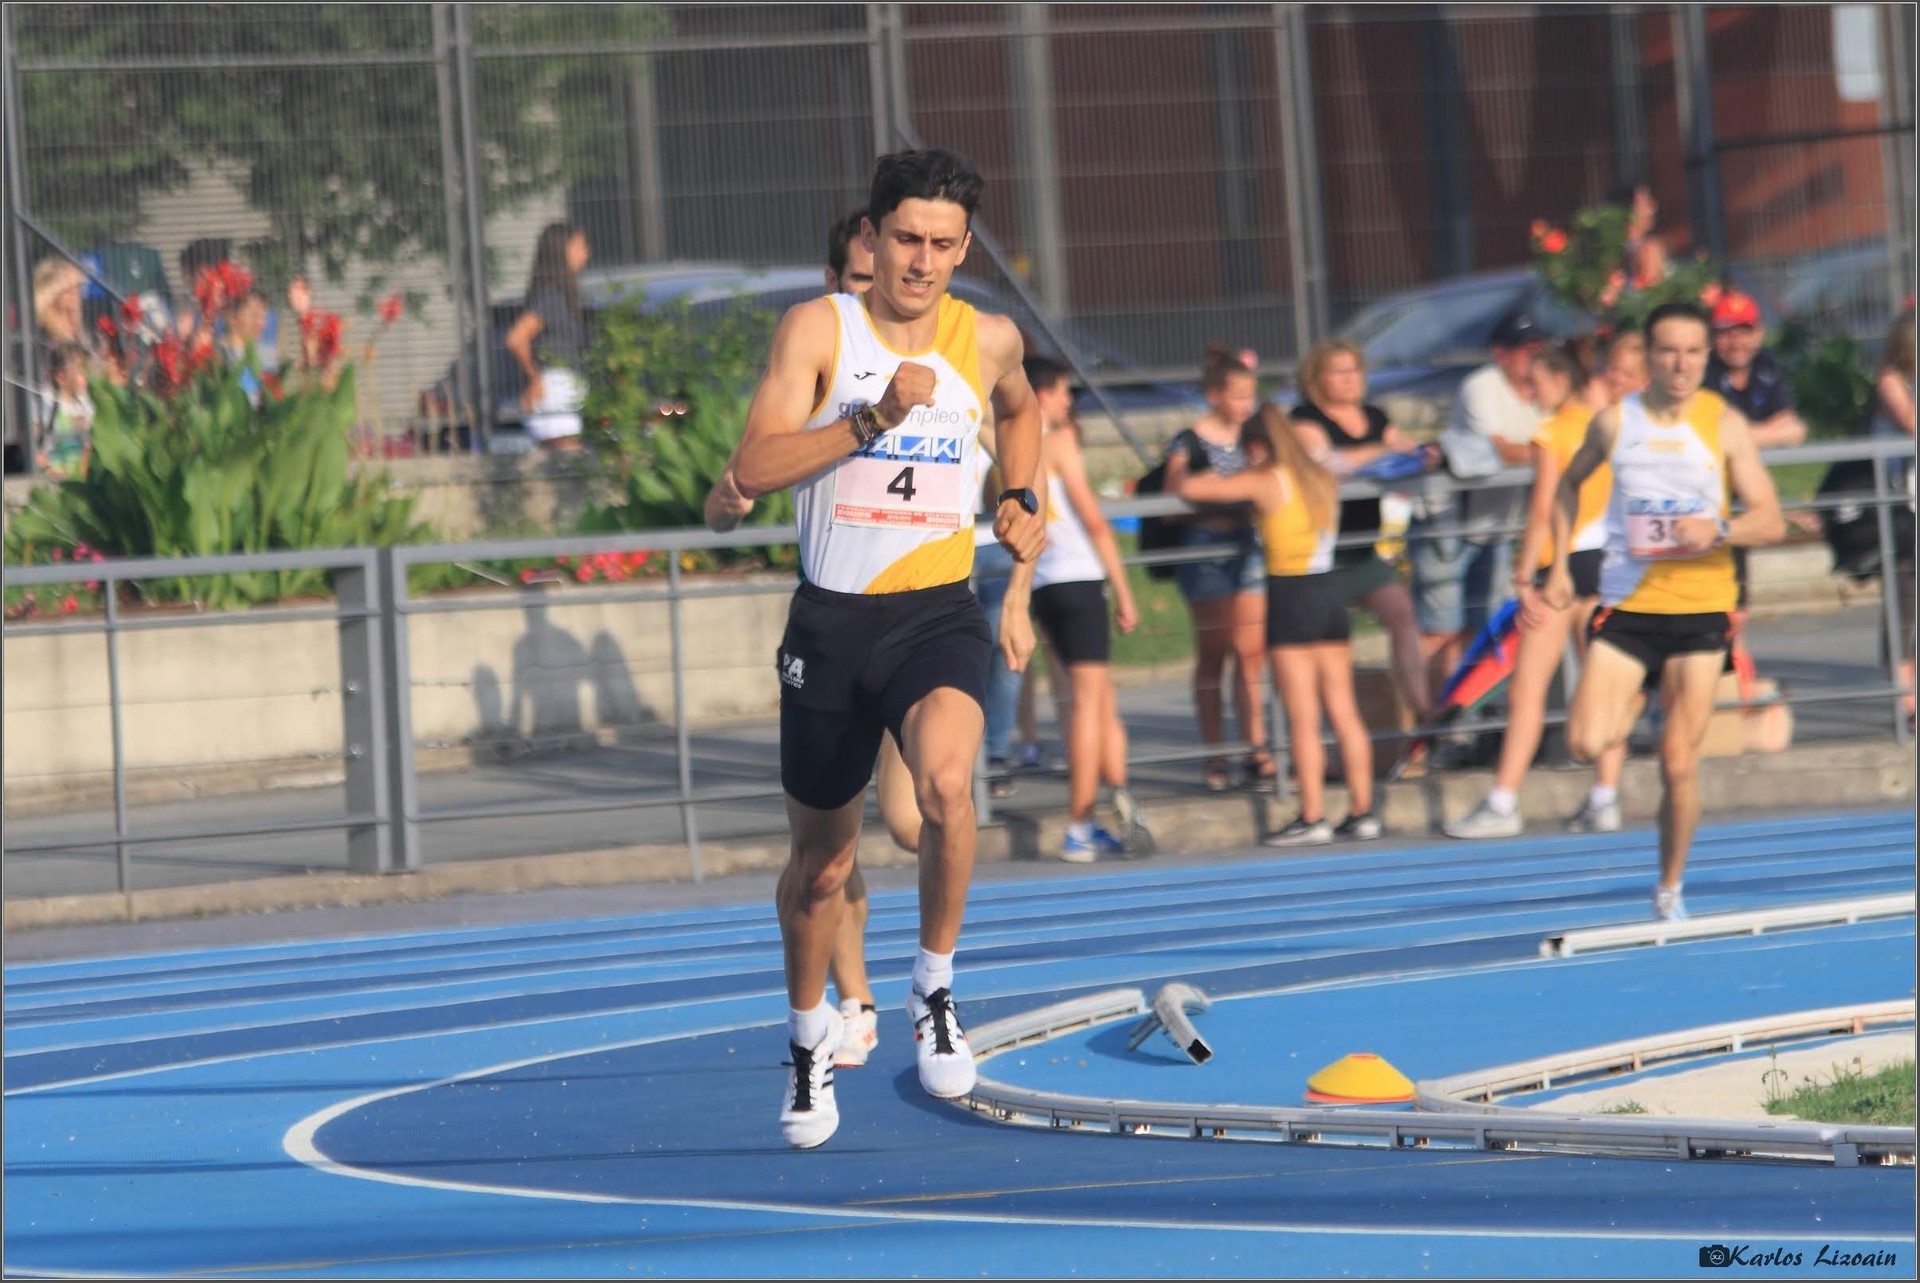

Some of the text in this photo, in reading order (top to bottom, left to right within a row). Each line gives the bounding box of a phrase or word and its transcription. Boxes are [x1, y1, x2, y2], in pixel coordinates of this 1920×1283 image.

[866, 434, 960, 459] ALAKI
[887, 467, 916, 502] 4
[1648, 519, 1676, 542] 3
